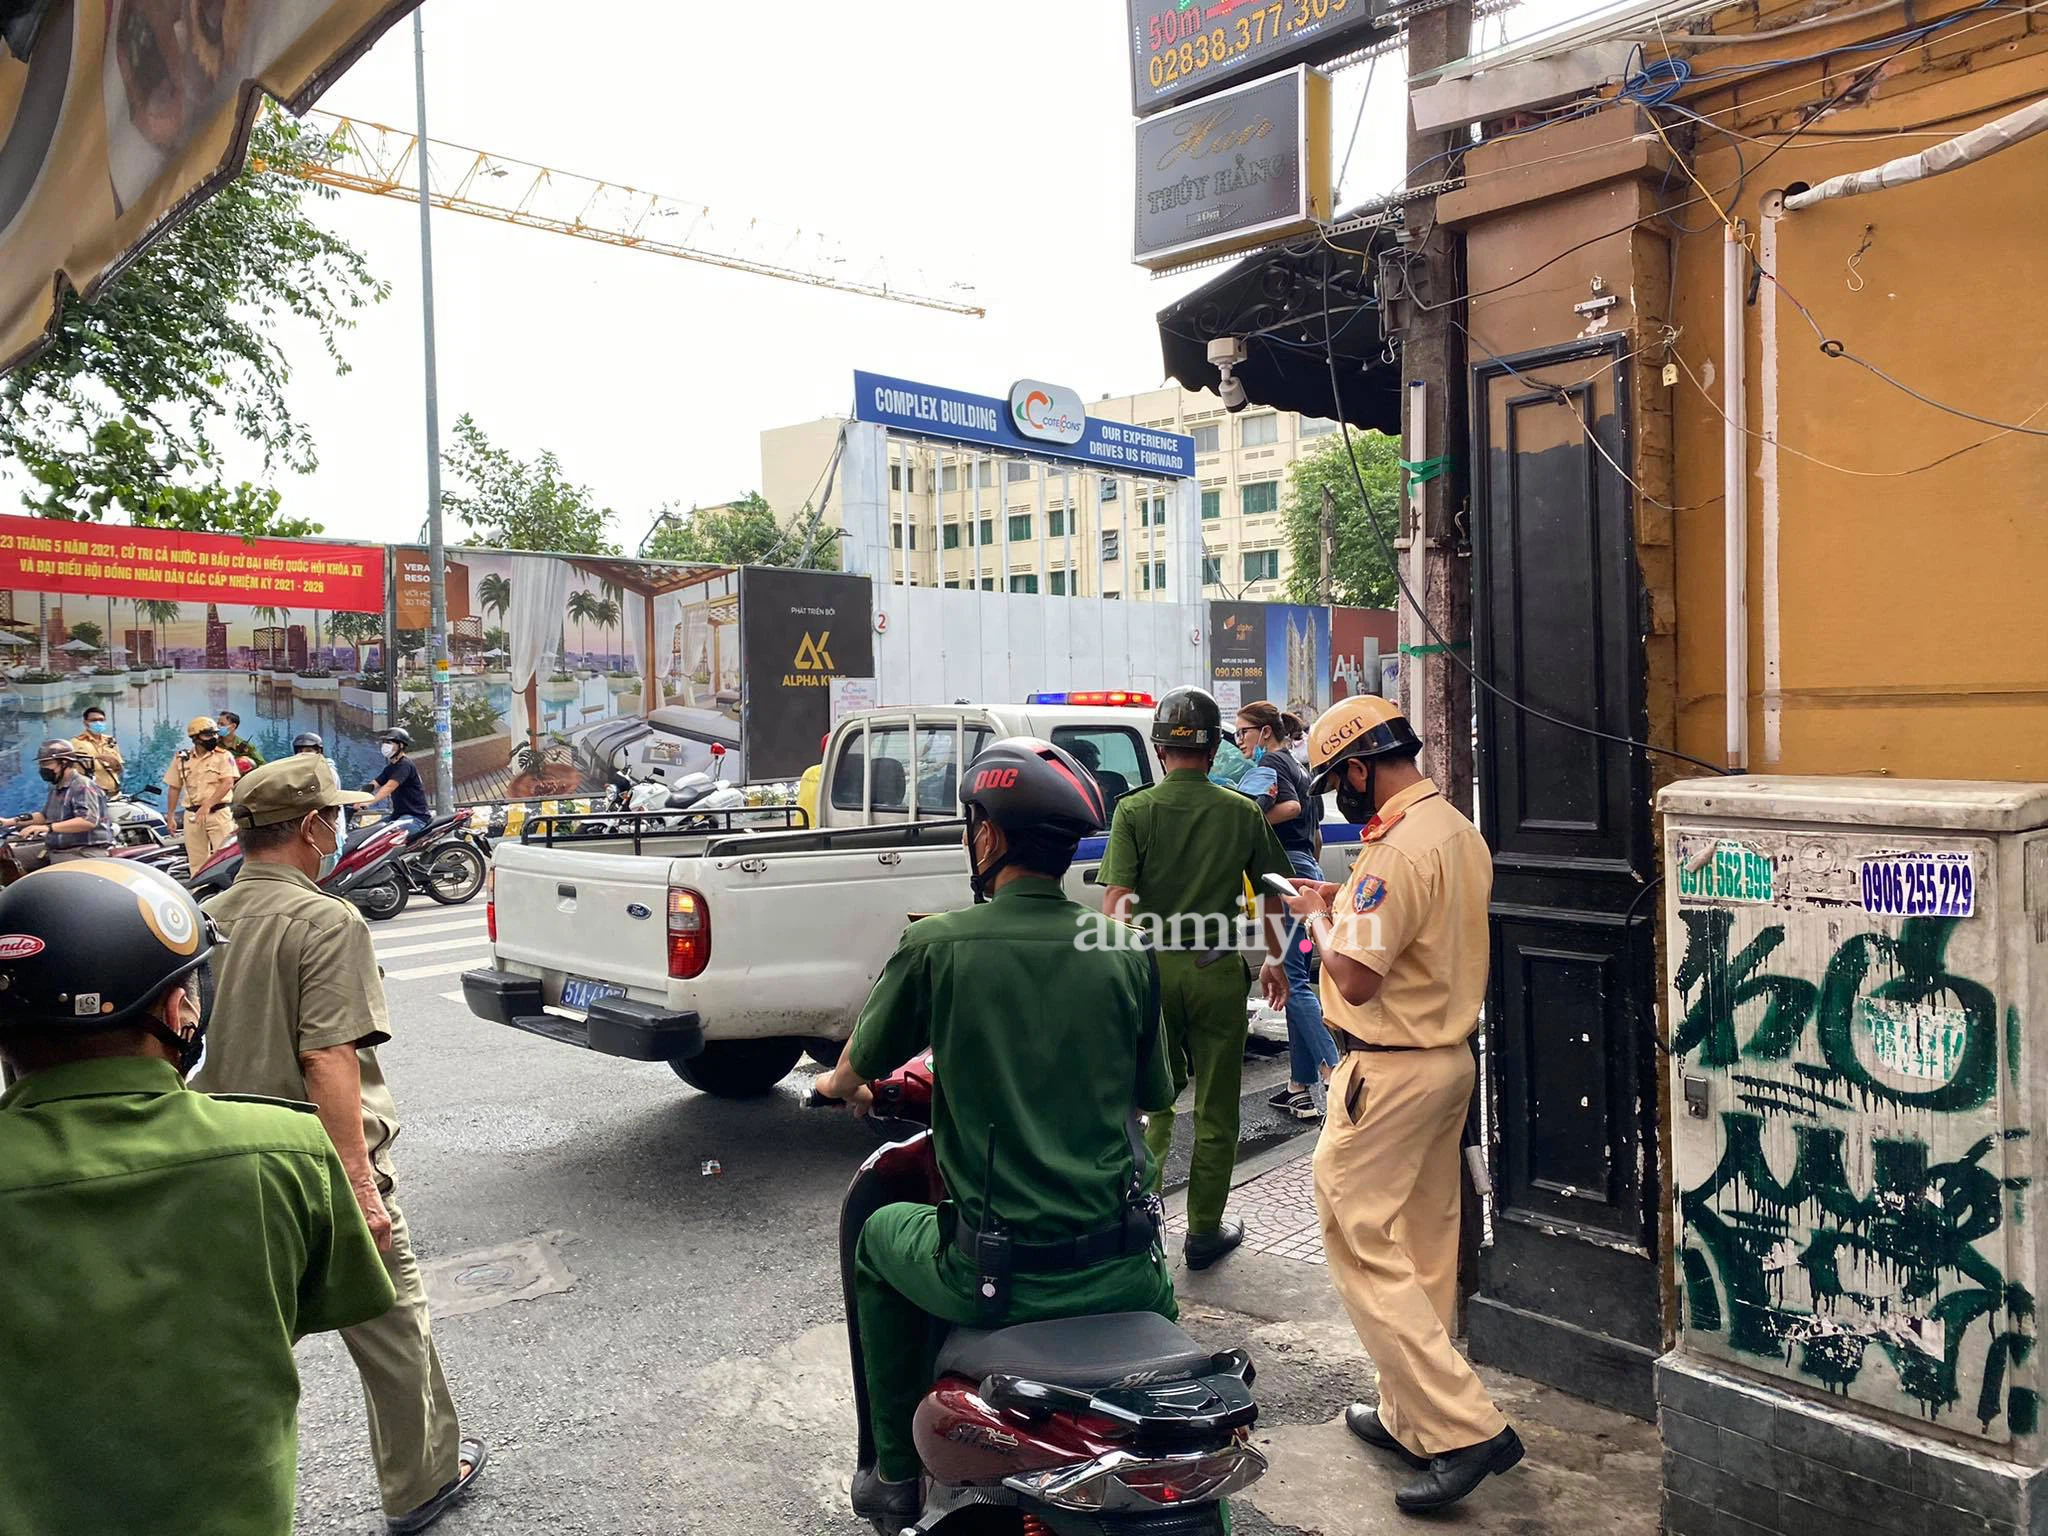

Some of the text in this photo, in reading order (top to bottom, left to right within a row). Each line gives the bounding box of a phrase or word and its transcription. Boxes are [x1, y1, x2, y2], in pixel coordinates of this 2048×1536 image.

[1149, 5, 1200, 51] 50m
[875, 386, 997, 433] COMPLEX BUILDING
[1090, 442, 1183, 470] DRIVES US FORWARD
[1101, 425, 1178, 452] OUR EXPERIENCE
[0, 535, 14, 548] 23
[16, 534, 52, 552] THÁNG
[54, 540, 62, 553] 5
[64, 538, 89, 555] NĂM
[91, 543, 119, 559] 2021,
[121, 542, 136, 559] CỬ
[137, 547, 153, 561] TRI
[155, 545, 169, 562] CẢ
[171, 549, 197, 565] NƯỚC
[286, 557, 309, 573] QUỐC
[20, 556, 34, 572] VÀ
[37, 560, 55, 576] ĐẠI
[58, 558, 82, 576] BIỂU
[84, 562, 102, 580] HỘI
[104, 562, 132, 580] ĐỒNG
[134, 566, 162, 583] NHÂN
[164, 569, 185, 584] DÂN
[187, 569, 206, 586] CÁC
[208, 571, 227, 587] CẤP
[229, 574, 259, 590] NHIỆM
[274, 578, 294, 592] 2021
[303, 580, 325, 593] 2026
[878, 614, 886, 629] 2
[782, 675, 819, 687] ALPHA
[1215, 667, 1229, 677] 090
[1320, 716, 1365, 757] CSGT
[1862, 861, 1972, 915] 0906.255.229
